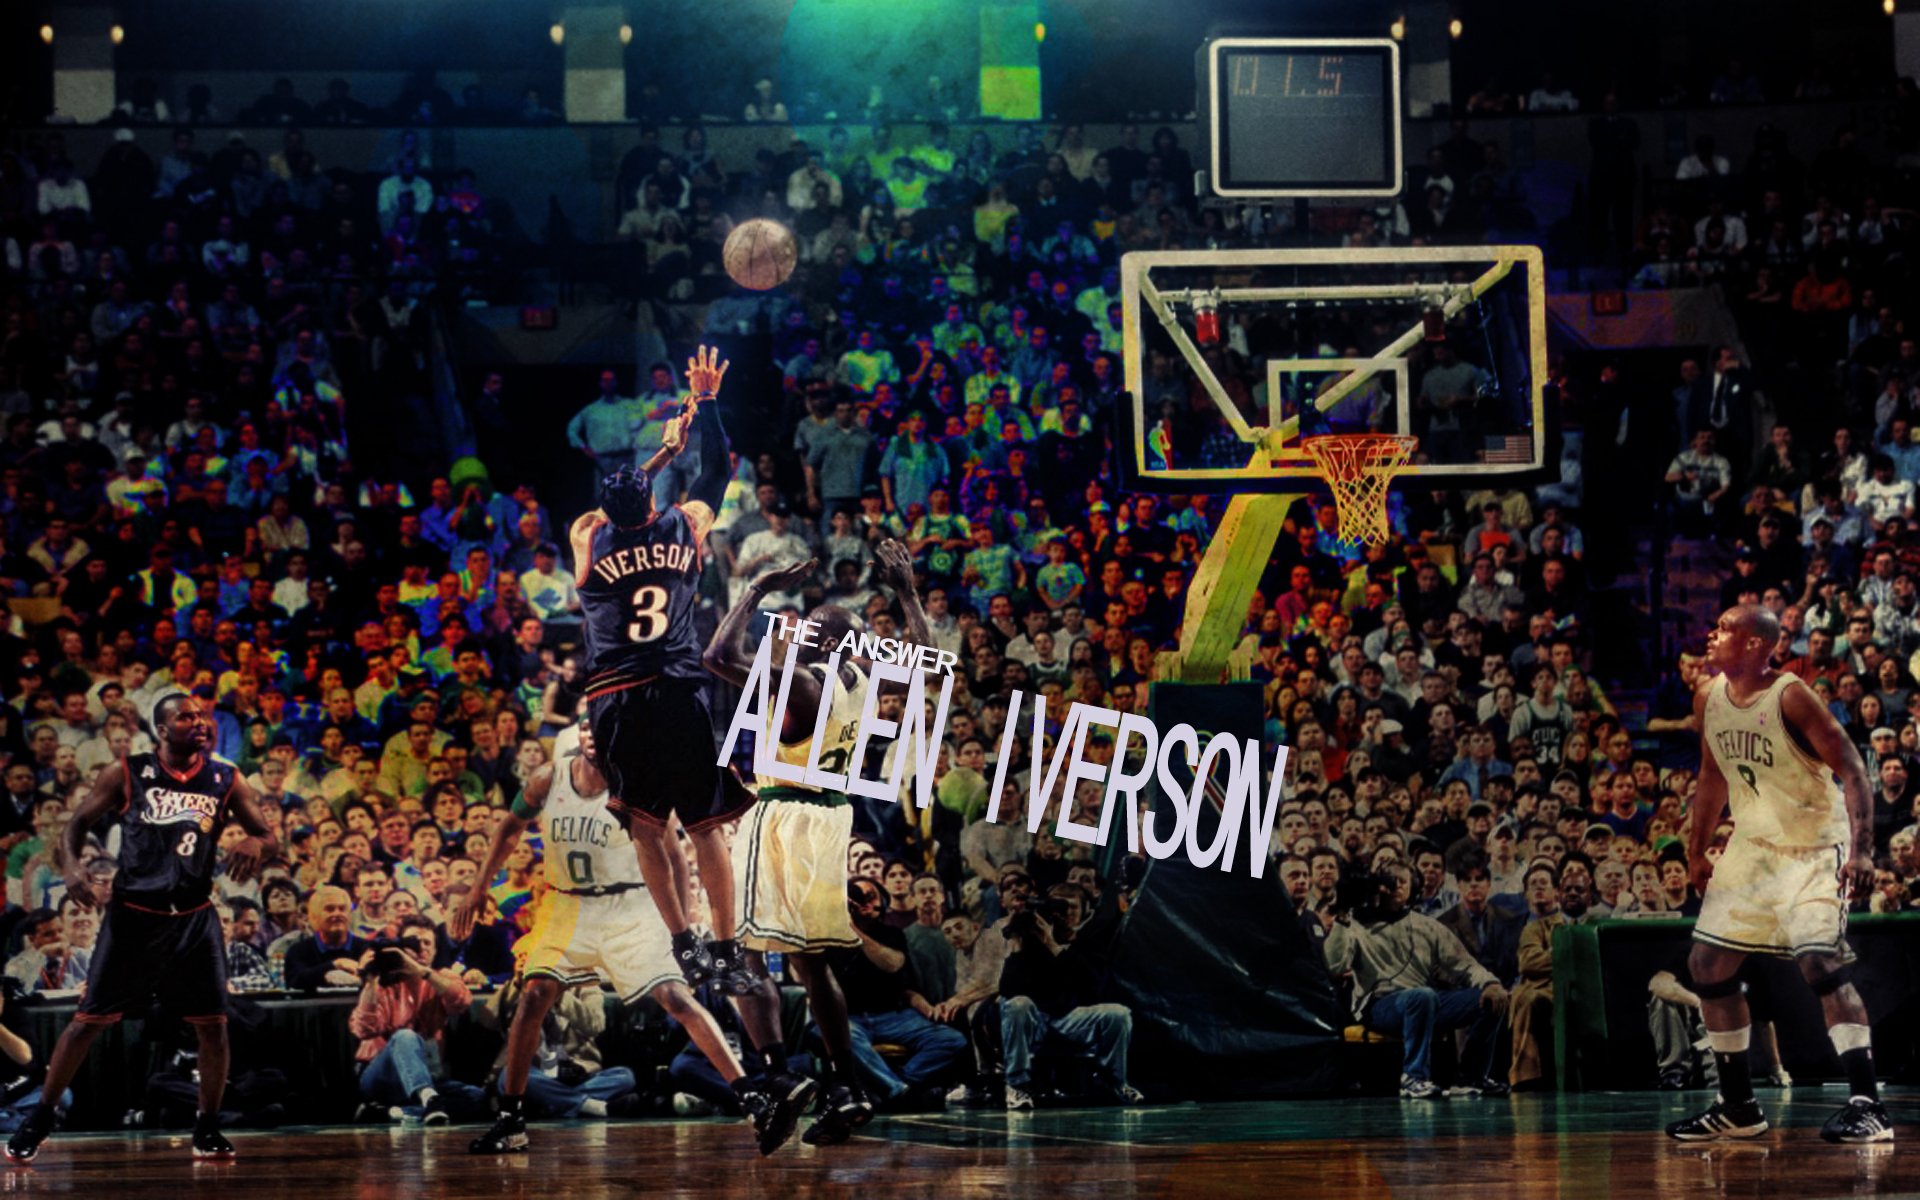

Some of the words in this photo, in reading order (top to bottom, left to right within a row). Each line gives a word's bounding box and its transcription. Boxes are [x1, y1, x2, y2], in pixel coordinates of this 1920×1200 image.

[593, 542, 696, 585] IVERSON
[627, 585, 670, 643] 3
[1715, 729, 1773, 767] CELTICS
[176, 831, 199, 857] 8
[551, 816, 612, 848] CELTICS
[567, 850, 594, 885] 0
